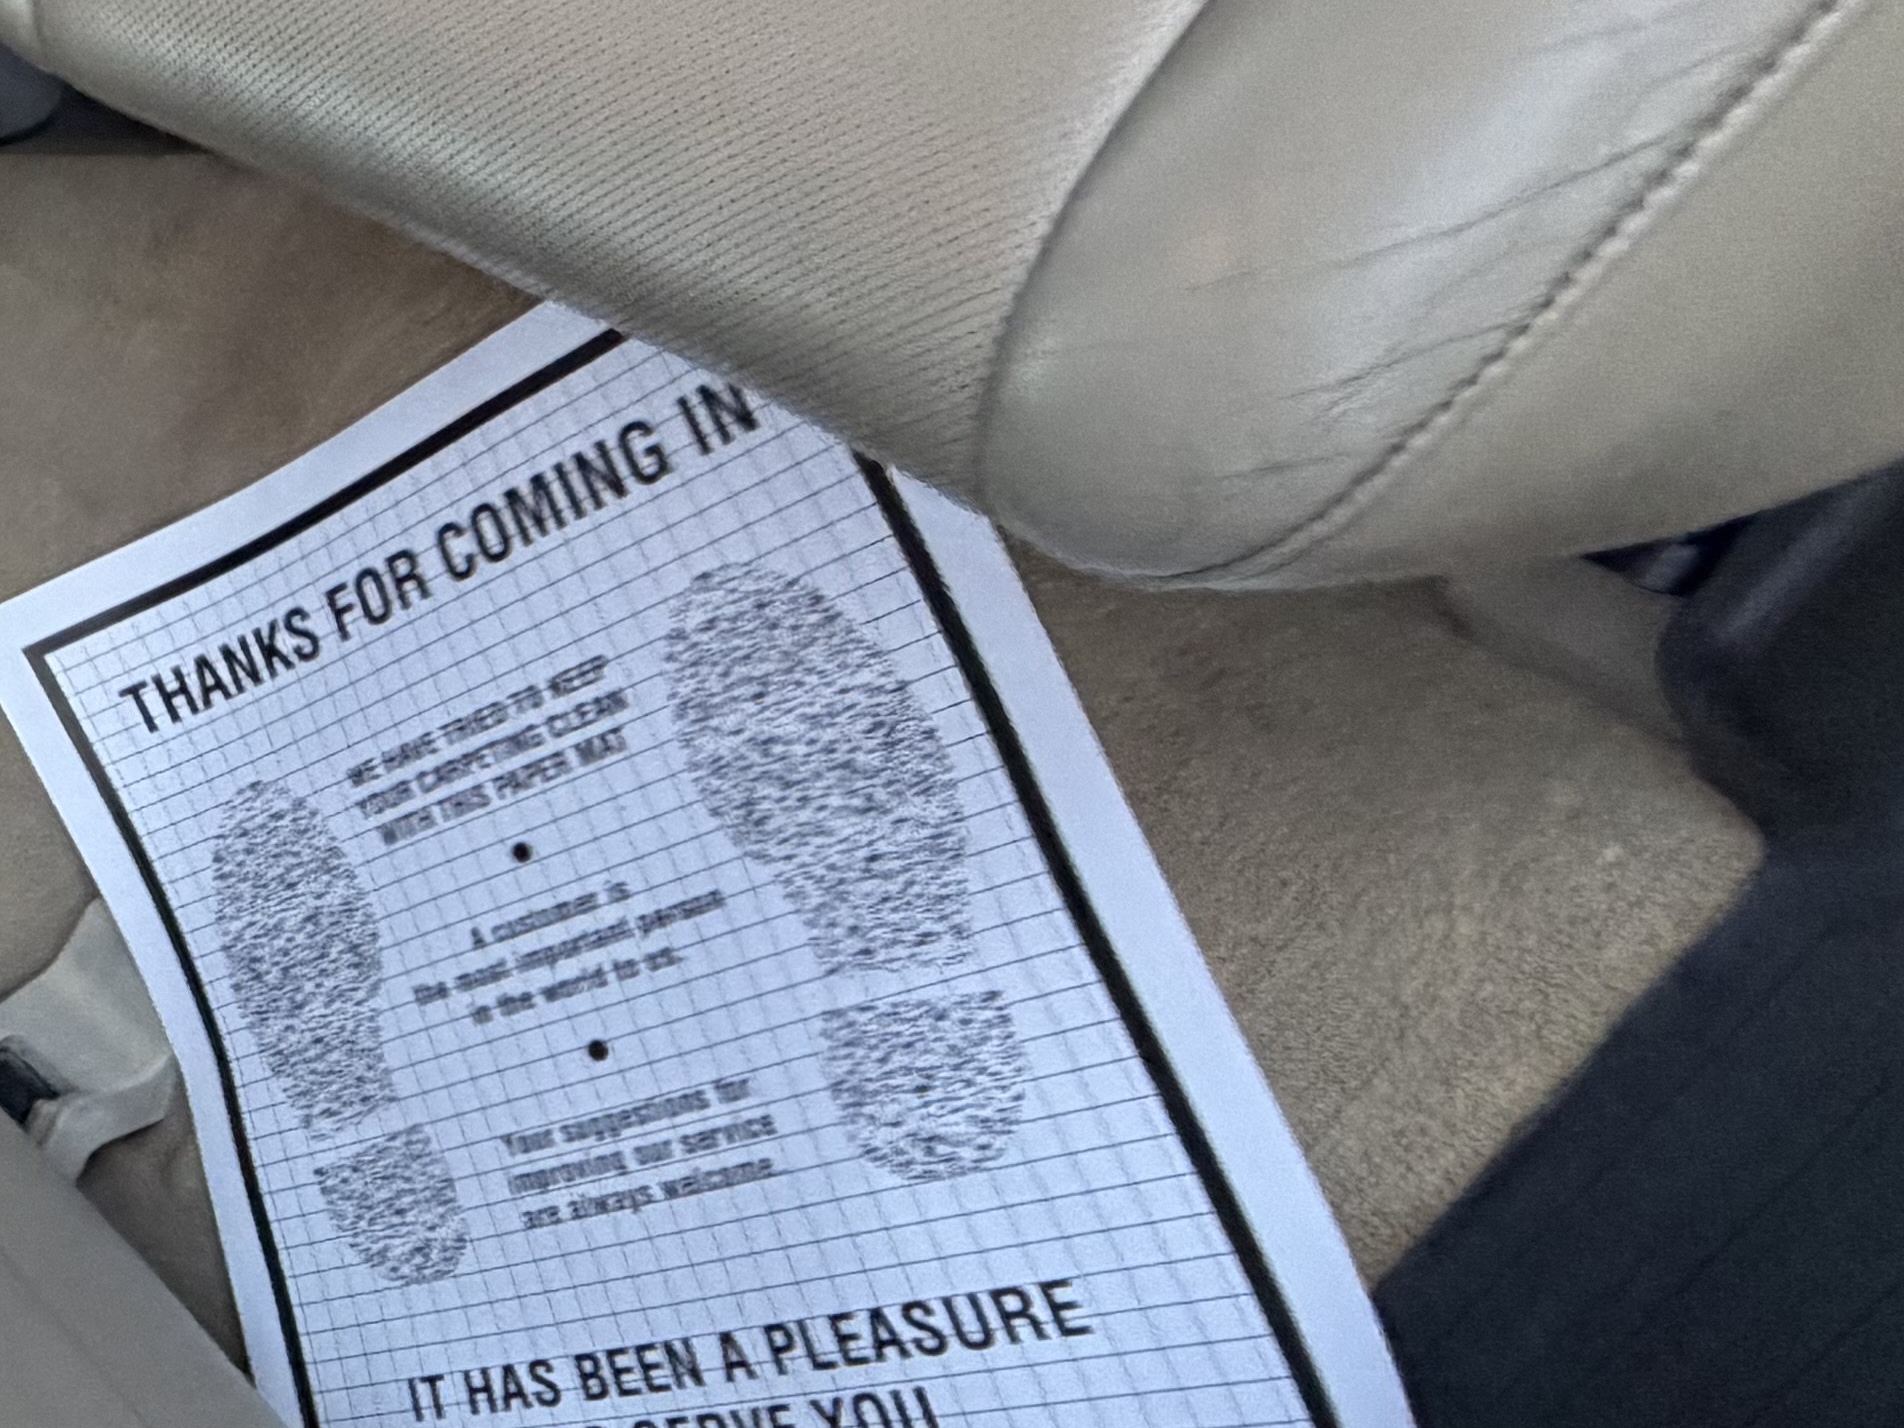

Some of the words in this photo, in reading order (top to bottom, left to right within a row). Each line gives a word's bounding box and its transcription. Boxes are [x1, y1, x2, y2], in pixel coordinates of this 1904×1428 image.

[119, 606, 321, 733] THANKS
[325, 549, 432, 641] FOR
[435, 420, 671, 582] COMING
[676, 380, 762, 456] IN
[408, 1375, 446, 1422] IT
[467, 1359, 563, 1415] HAS
[574, 1338, 706, 1401] BEEN
[719, 1331, 758, 1384] A
[765, 1279, 1093, 1375] PLEASURE
